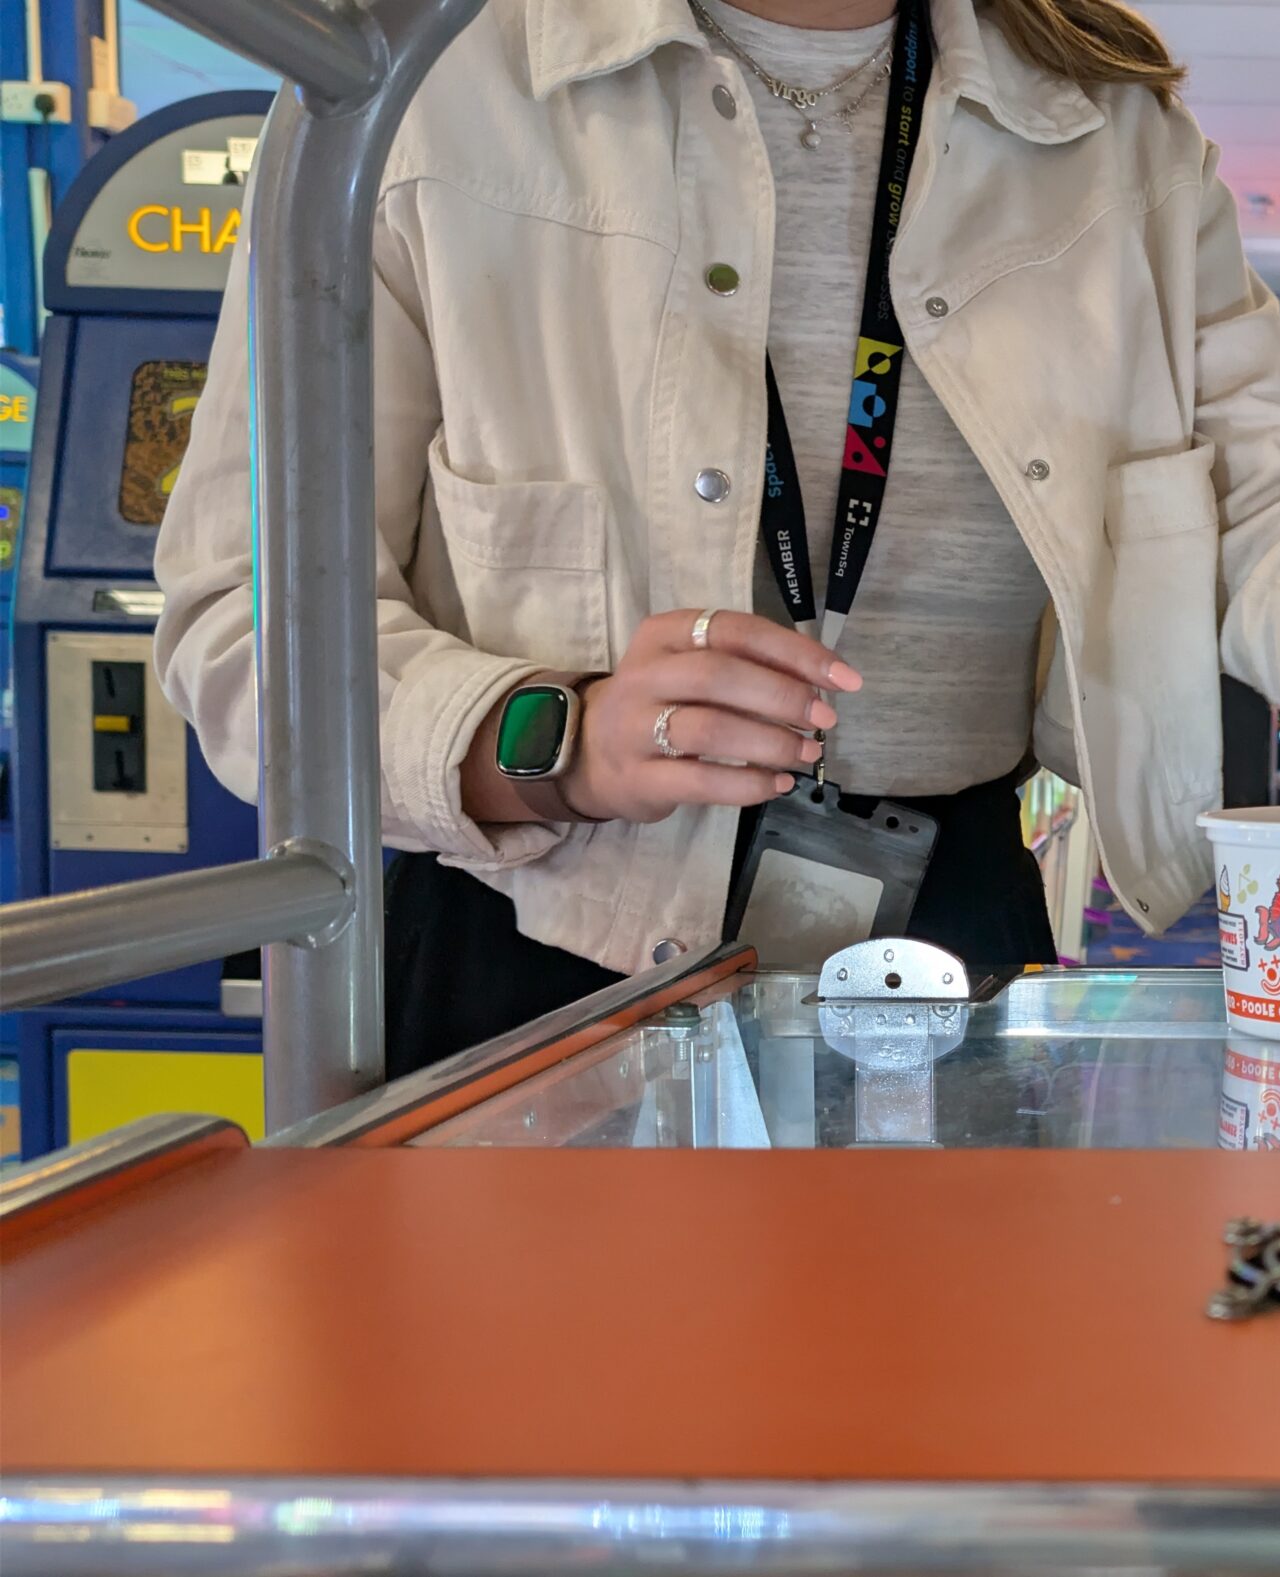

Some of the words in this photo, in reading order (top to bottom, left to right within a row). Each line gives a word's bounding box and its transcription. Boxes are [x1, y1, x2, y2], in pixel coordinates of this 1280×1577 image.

[904, 20, 918, 82] support
[767, 79, 818, 109] Virgo
[898, 105, 913, 145] start
[894, 148, 908, 181] and
[888, 182, 903, 227] grow
[765, 450, 784, 498] spac
[777, 529, 802, 604] MEMBER
[835, 527, 854, 578] Townsq
[1241, 999, 1275, 1018] POOLE
